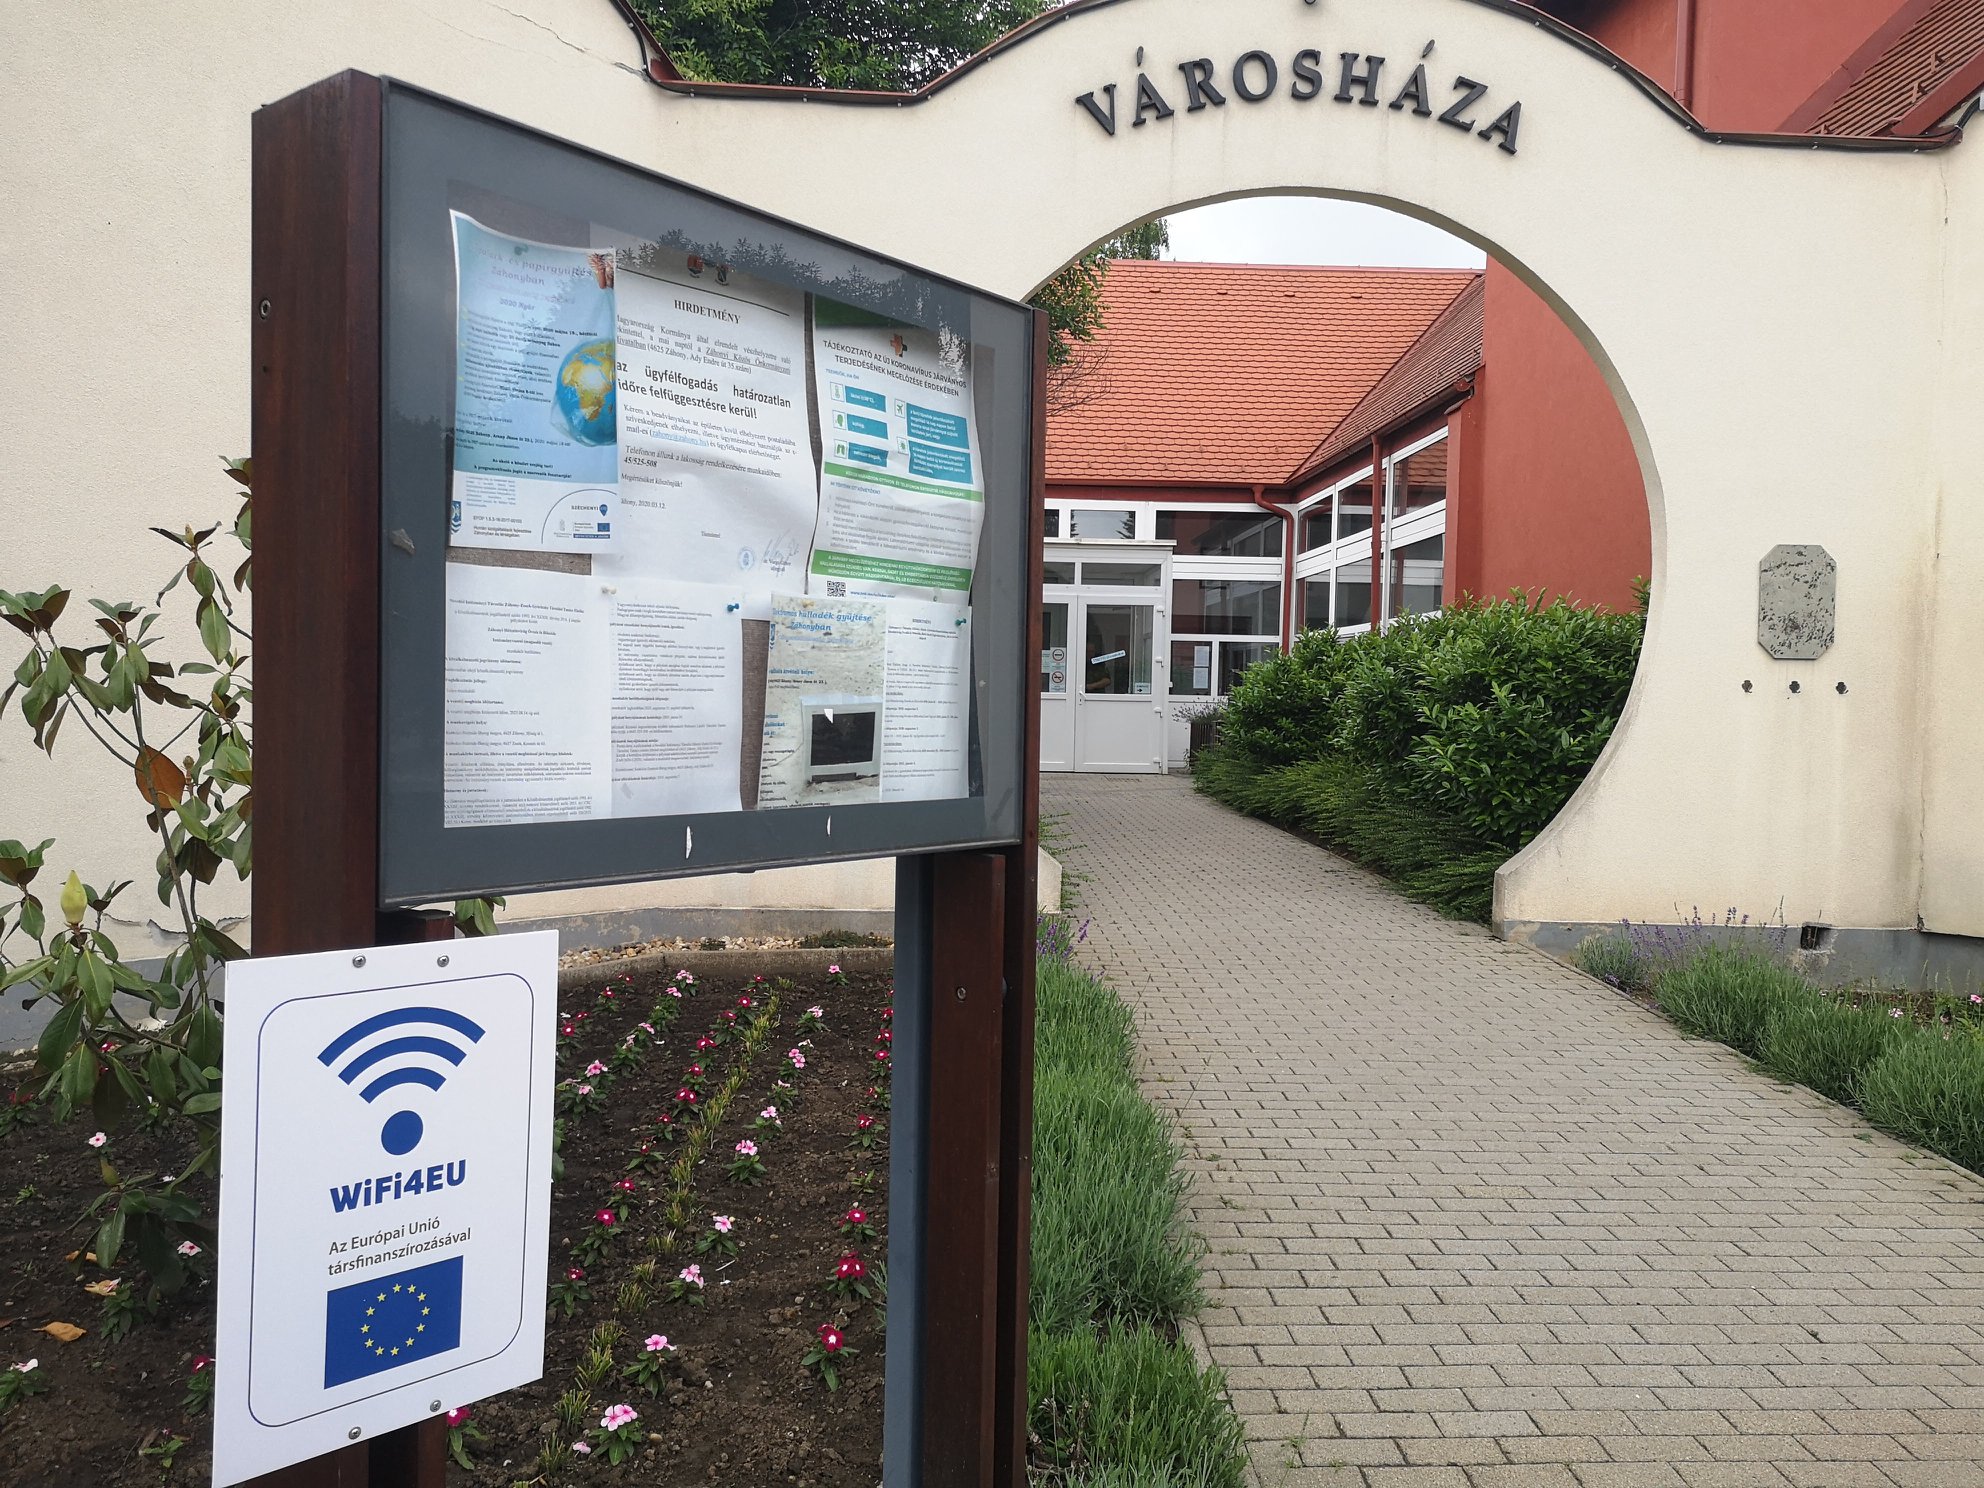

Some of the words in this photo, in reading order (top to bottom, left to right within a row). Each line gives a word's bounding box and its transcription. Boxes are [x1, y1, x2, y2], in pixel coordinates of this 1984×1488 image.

[1075, 39, 1524, 156] VÁROSHÁZA
[673, 299, 741, 325] HIRDETMÉNY
[658, 335, 670, 345] mai
[674, 340, 693, 351] naptól
[660, 325, 691, 341] Kormánya
[696, 333, 709, 344] által
[703, 356, 720, 368] Endre
[727, 361, 735, 370] 35
[822, 339, 874, 360] TÁJÉKOZTATÓ
[873, 352, 883, 363] AZ
[882, 354, 891, 366] ÚJ
[890, 358, 932, 380] KORONAVÍRUS
[932, 371, 968, 390] JÁRVÁNYOS
[834, 354, 887, 376] TERJEDÉSÉNEK
[886, 368, 924, 388] MEGELŐZÉSE
[923, 380, 960, 398] ÉRDEKÉBEN
[616, 360, 628, 373] az
[644, 365, 719, 393] ügyfélfogadás
[733, 384, 792, 409] határozatlan
[617, 378, 648, 396] időre
[648, 385, 727, 414] felfüggesztésre
[728, 402, 758, 420] kerül!
[625, 444, 656, 458] Telefonon
[656, 450, 674, 461] állunk
[680, 454, 706, 467] lakosság
[705, 460, 747, 473] rendelkezésére
[329, 1159, 466, 1214] WiFi4EU
[328, 1239, 348, 1256] Az
[351, 1226, 406, 1251] Európai
[408, 1215, 441, 1239] Unió
[328, 1227, 472, 1276] társfinanszírozásával
